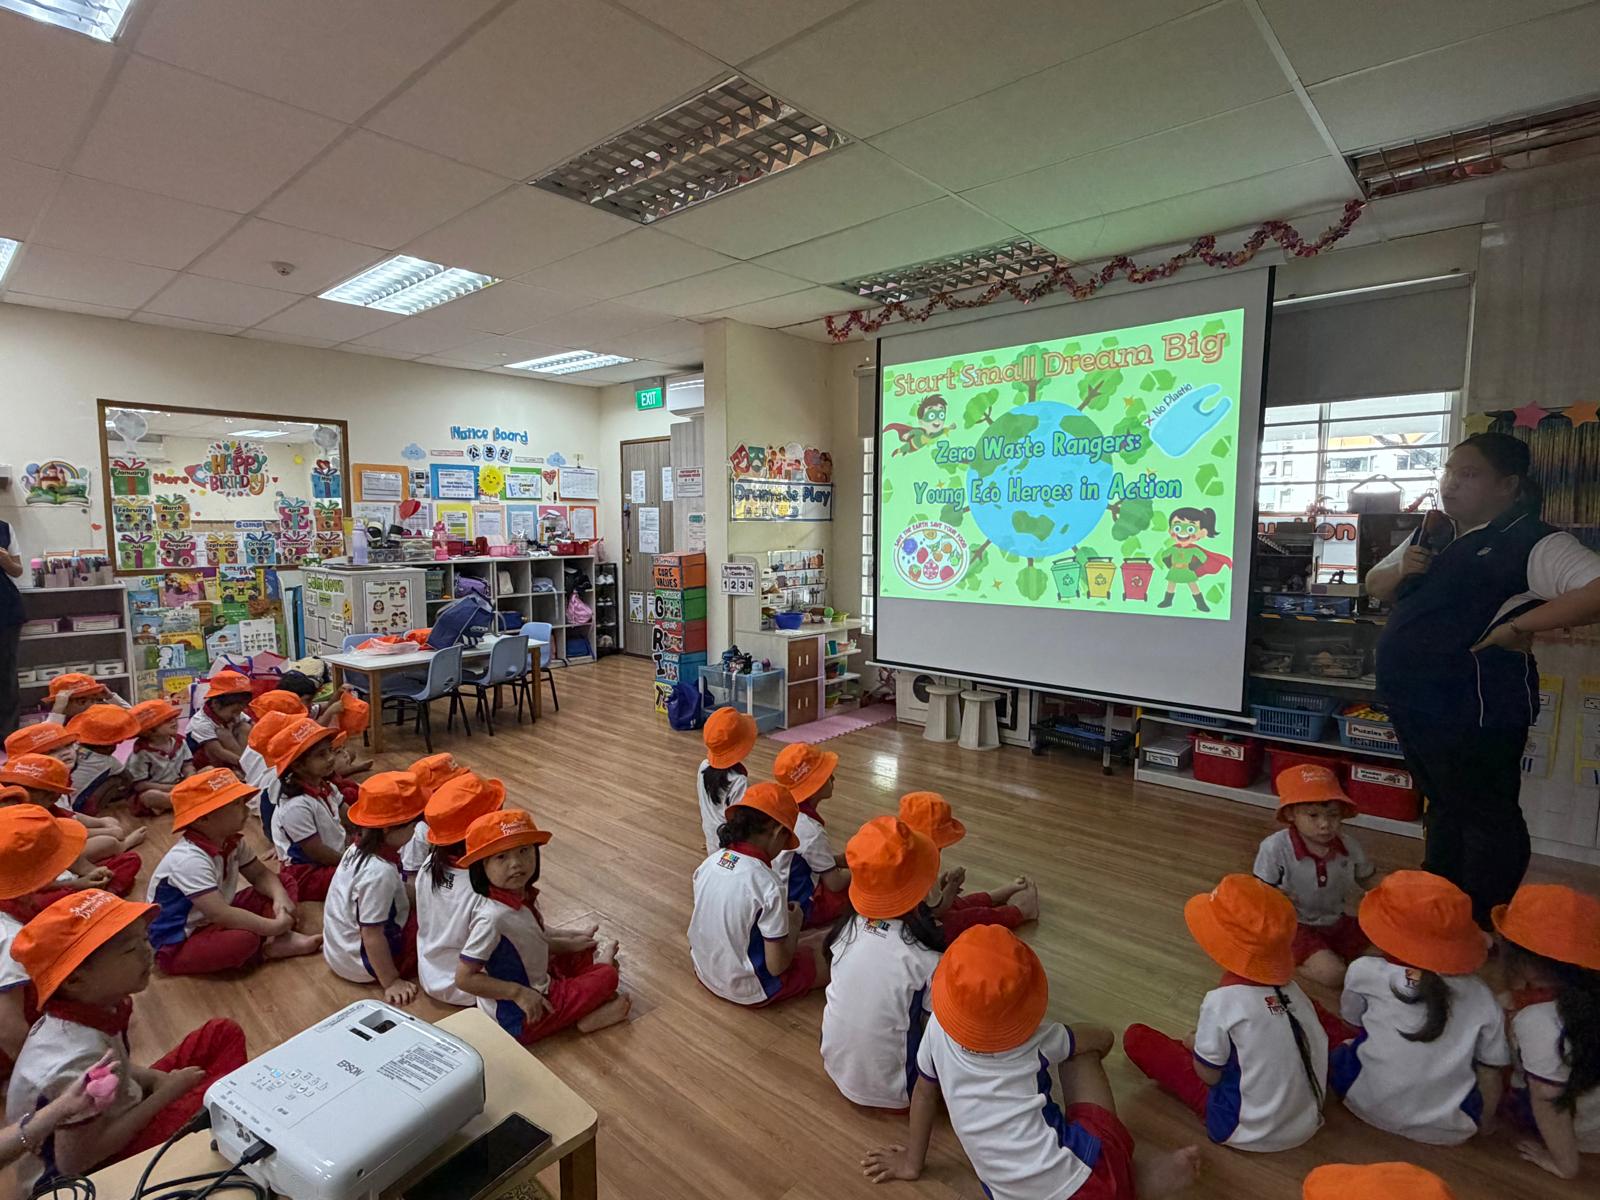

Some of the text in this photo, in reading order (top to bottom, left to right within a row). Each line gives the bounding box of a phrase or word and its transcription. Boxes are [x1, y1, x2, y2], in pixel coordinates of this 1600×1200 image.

[894, 330, 1226, 396] Start Small Dream Big
[641, 391, 656, 406] EXIT
[1153, 383, 1193, 417] No Plastic
[450, 426, 528, 445] Notice Board
[935, 431, 1142, 464] Zero Waste Rangers:
[211, 453, 268, 475] HAPPY
[802, 486, 831, 507] Play
[914, 472, 1182, 512] Young Eco Heroes in Action
[723, 580, 754, 590] 1 2 3 4
[1353, 726, 1382, 737] Puzzles
[336, 1059, 365, 1077] EPSON
